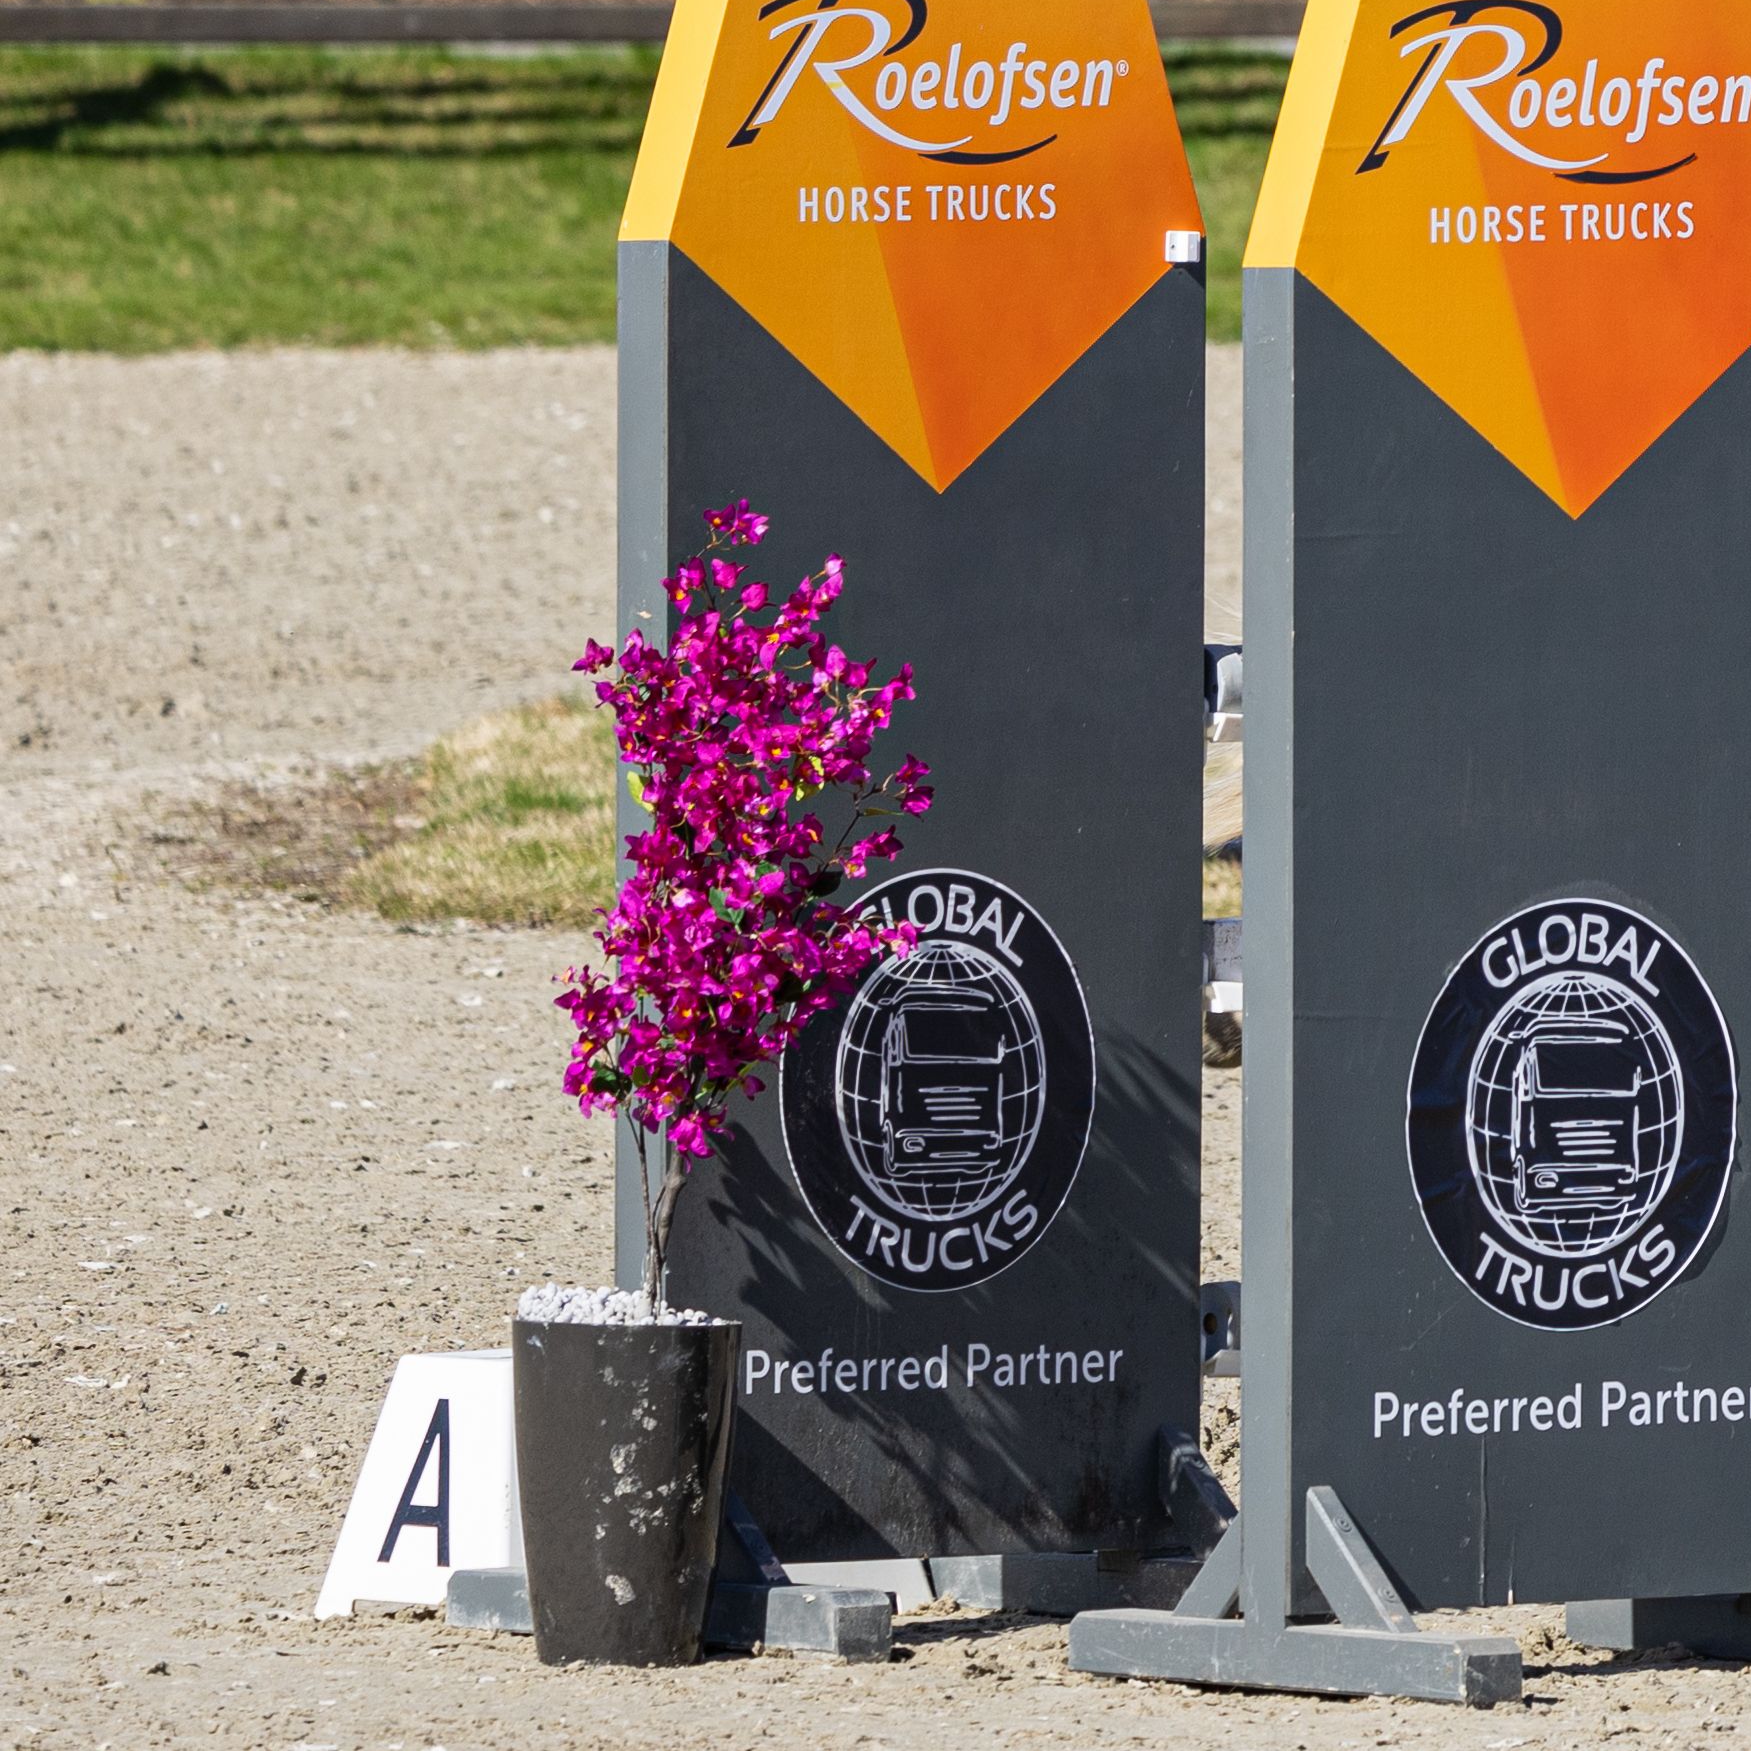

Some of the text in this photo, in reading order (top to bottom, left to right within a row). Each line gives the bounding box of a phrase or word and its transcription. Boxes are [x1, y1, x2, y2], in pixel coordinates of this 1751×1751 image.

[799, 183, 1057, 222] HORSE TRUCKS
[1430, 201, 1695, 243] HORSE TRUCKS
[1482, 913, 1662, 997] GLOBAL
[845, 1188, 1038, 1272] TRUCKS
[1475, 1223, 1676, 1310] TRUCKS
[745, 1343, 1123, 1394] Preferred Partner
[1374, 1383, 1582, 1438] Preferred
[377, 1398, 450, 1567] A
